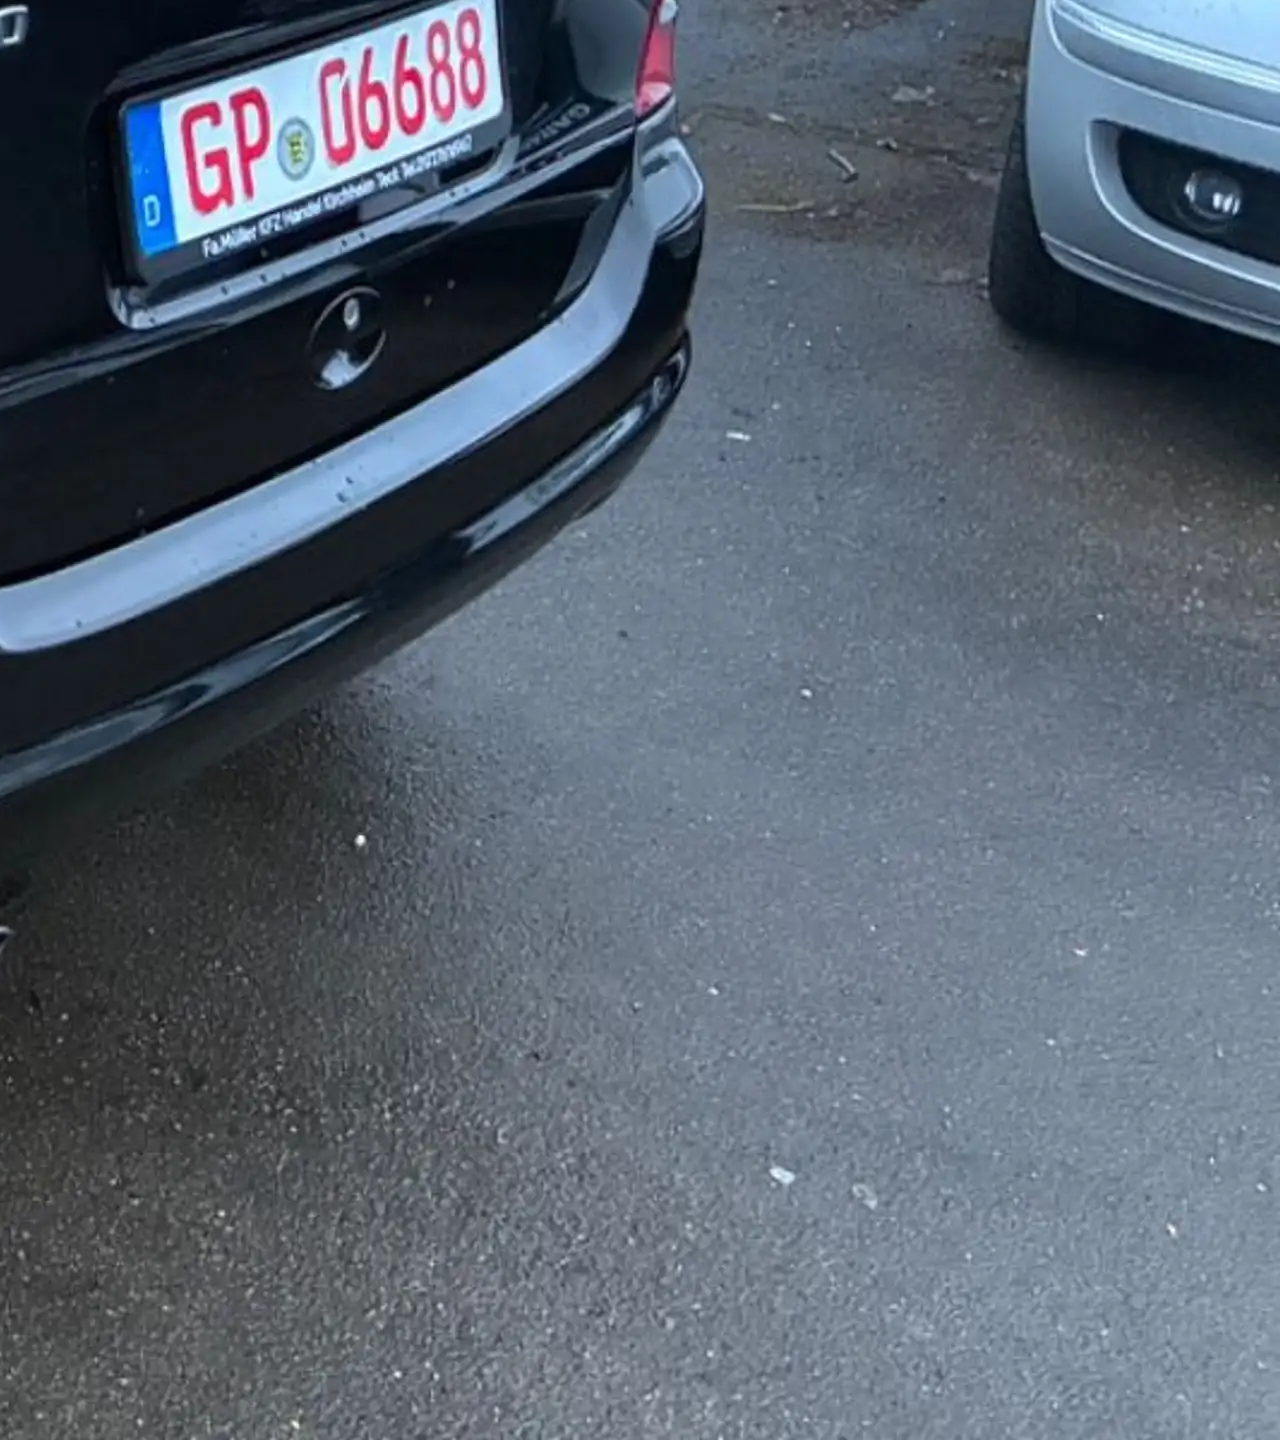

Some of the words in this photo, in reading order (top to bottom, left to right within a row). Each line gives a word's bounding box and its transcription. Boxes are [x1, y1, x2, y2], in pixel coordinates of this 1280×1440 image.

[180, 86, 271, 217] GP
[319, 7, 487, 167] 06688
[143, 194, 161, 227] D
